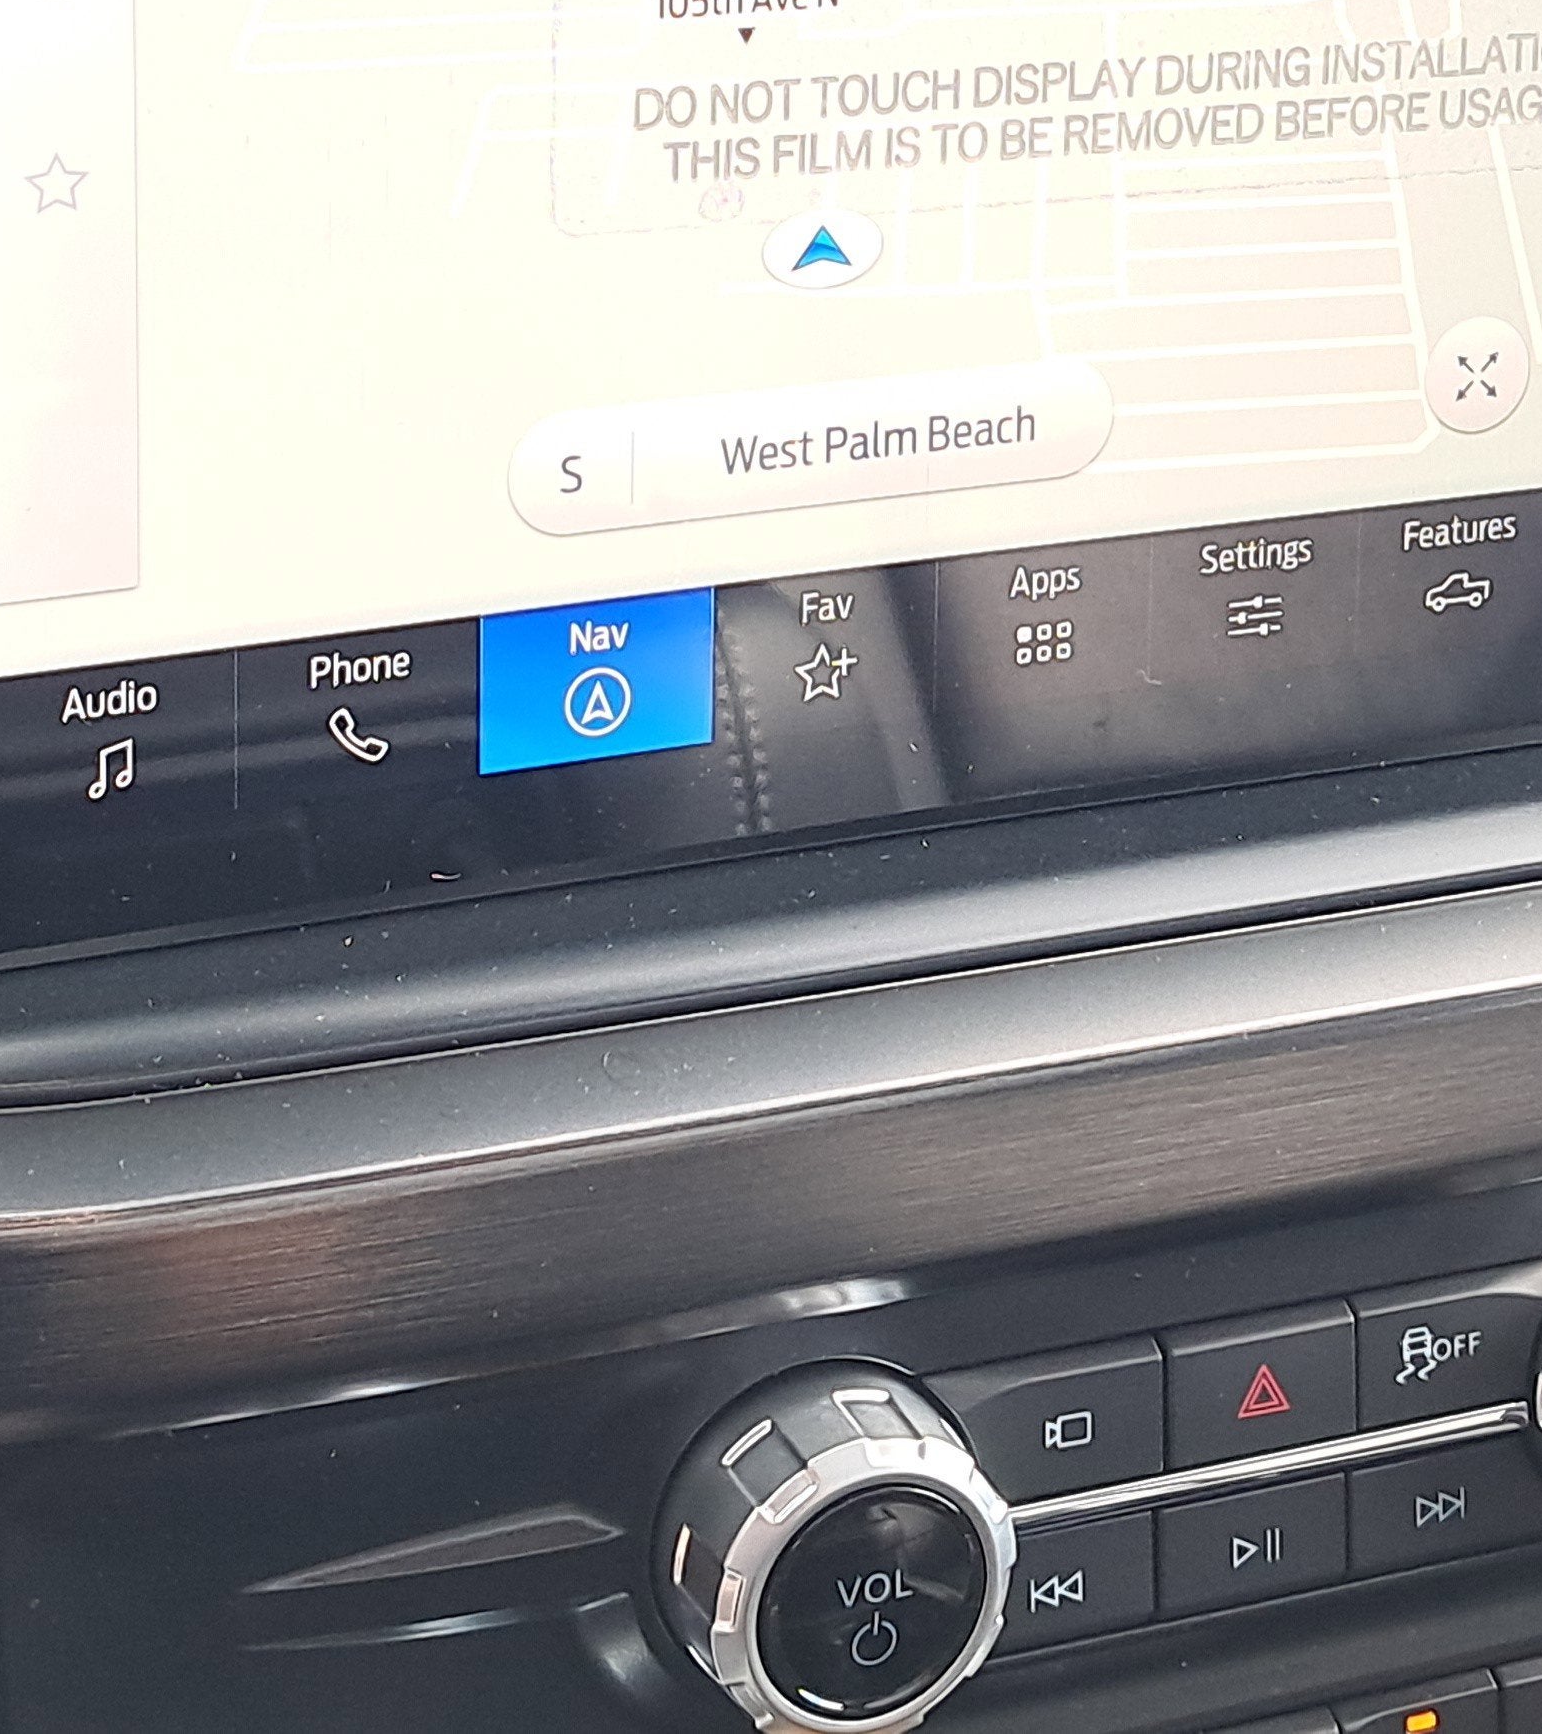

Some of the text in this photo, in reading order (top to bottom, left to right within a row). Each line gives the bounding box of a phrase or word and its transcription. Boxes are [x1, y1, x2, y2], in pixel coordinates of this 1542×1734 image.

[634, 87, 697, 131] DO
[709, 78, 801, 126] NOT
[811, 69, 959, 118] TOUCH
[973, 56, 1146, 108] DISPLAY
[1155, 48, 1311, 95] DURING
[663, 138, 760, 184] THIS
[772, 129, 872, 177] FILM
[884, 126, 920, 169] IS
[932, 123, 989, 165] TO
[999, 117, 1053, 161] BE
[1063, 101, 1264, 156] REMOVED
[1275, 92, 1431, 142] BEFORE
[721, 405, 1036, 476] West Palm Beach
[560, 455, 583, 493] S
[1402, 512, 1517, 552] Features
[1199, 534, 1313, 576] Settings
[1009, 566, 1082, 602] Apps
[800, 591, 854, 624] Fav
[569, 620, 629, 655] Nav
[309, 651, 410, 690] Phone
[61, 681, 158, 723] Audio
[1433, 1331, 1482, 1362] OFF
[837, 1571, 913, 1608] VOL
